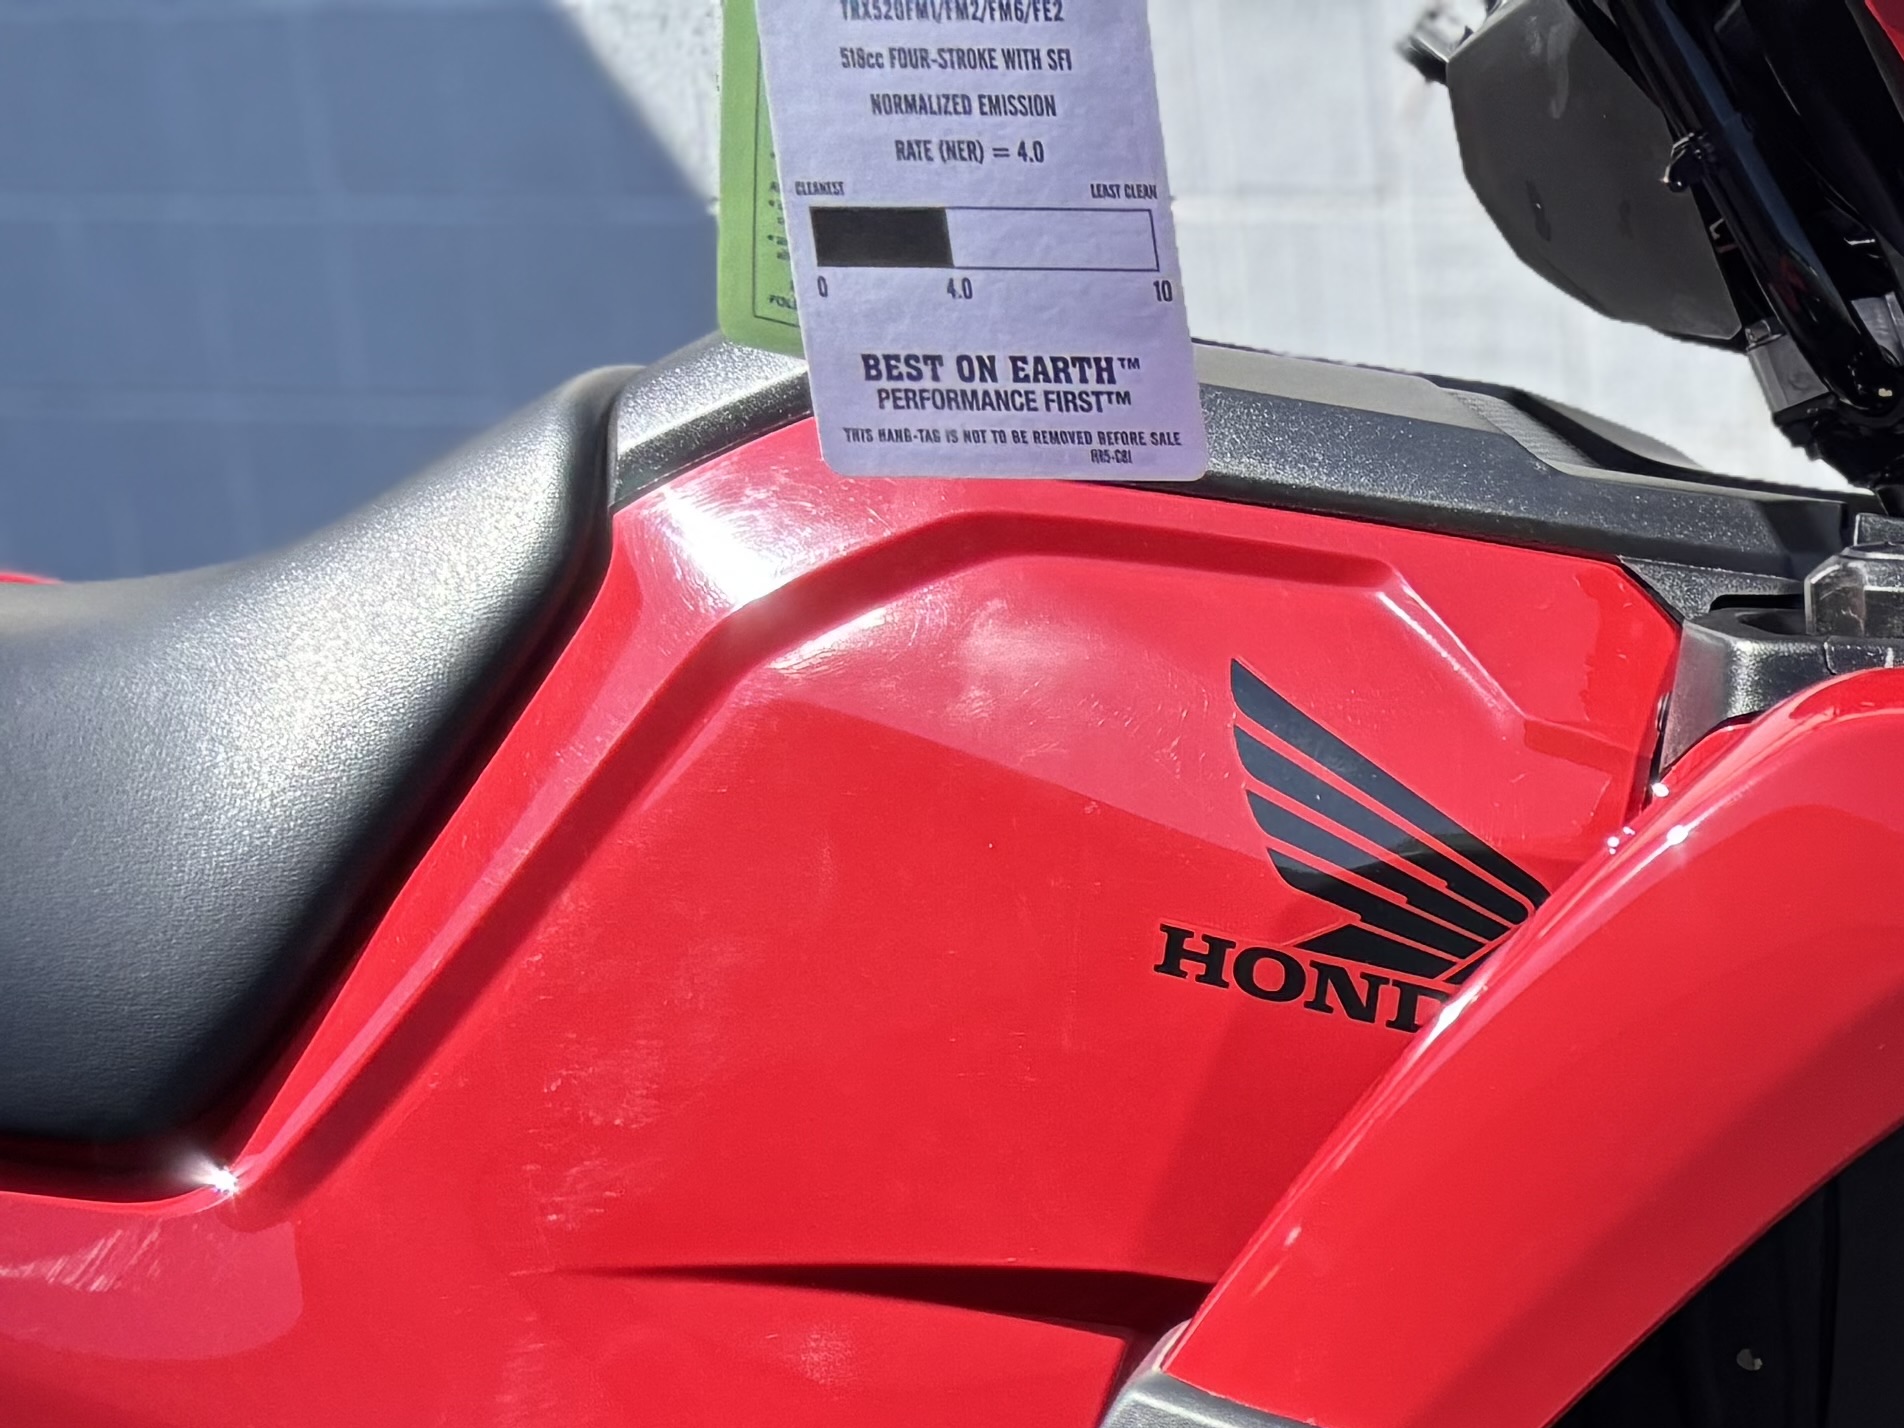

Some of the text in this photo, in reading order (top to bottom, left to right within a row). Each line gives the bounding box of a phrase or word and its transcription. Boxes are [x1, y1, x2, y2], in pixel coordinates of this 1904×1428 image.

[889, 47, 998, 70] FOUR-STROKE
[1001, 49, 1042, 70] WITH
[1047, 48, 1073, 71] SFI
[870, 94, 1057, 117] NORMALIZED EMISSION
[895, 140, 933, 162] RATE
[939, 139, 984, 164] (NER)
[1017, 140, 1044, 163] 4.0
[1089, 184, 1121, 198] LEAST
[818, 277, 828, 297] 0
[947, 278, 973, 299] 4.0
[1153, 280, 1173, 301] 10
[861, 354, 944, 382] BEST
[956, 354, 998, 383] ON
[877, 388, 1039, 412] PERFORMANCE
[843, 427, 1182, 446] THIS HANG-TAG IS NOT TO BE REMOVED BEFORE SALE
[1153, 923, 1455, 1034] HOND
